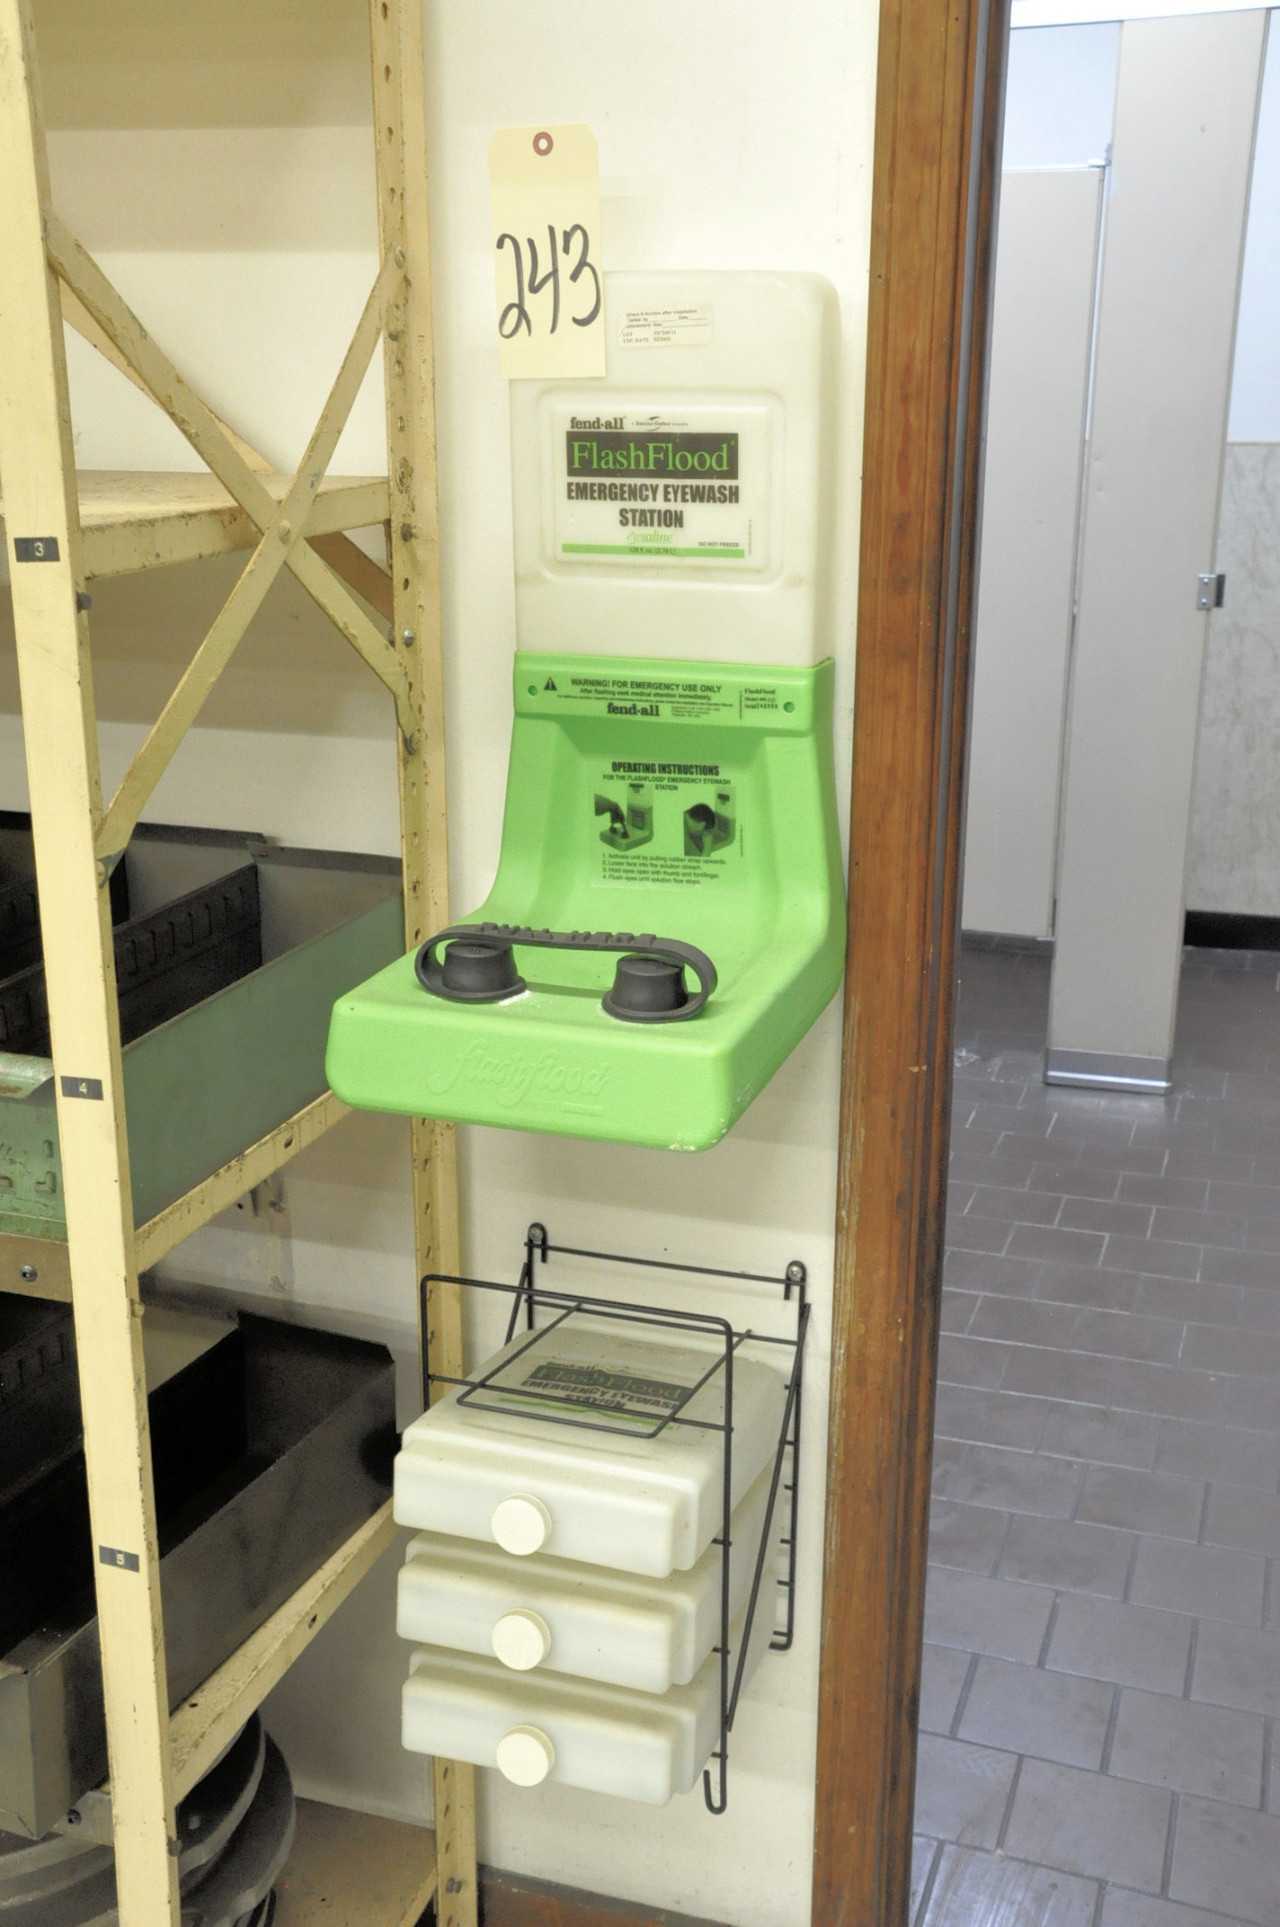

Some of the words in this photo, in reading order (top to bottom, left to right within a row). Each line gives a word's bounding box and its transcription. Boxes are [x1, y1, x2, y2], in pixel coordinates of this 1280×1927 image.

[496, 223, 601, 339] 243
[570, 440, 729, 472] FlashFlood
[567, 482, 659, 503] EMERGENCY
[663, 484, 740, 505] EYEWASH
[619, 508, 684, 528] STATION
[34, 542, 44, 557] 3
[570, 678, 610, 688] WARNING!
[612, 680, 628, 689] FOR
[630, 681, 680, 691] EMERGENCY
[682, 683, 698, 692] USE
[700, 684, 722, 693] ONLY
[612, 761, 656, 773] OPERATING
[658, 763, 720, 776] INSTRUCTIONS
[79, 1081, 88, 1095] 4
[520, 1380, 610, 1398] EMERGENCY
